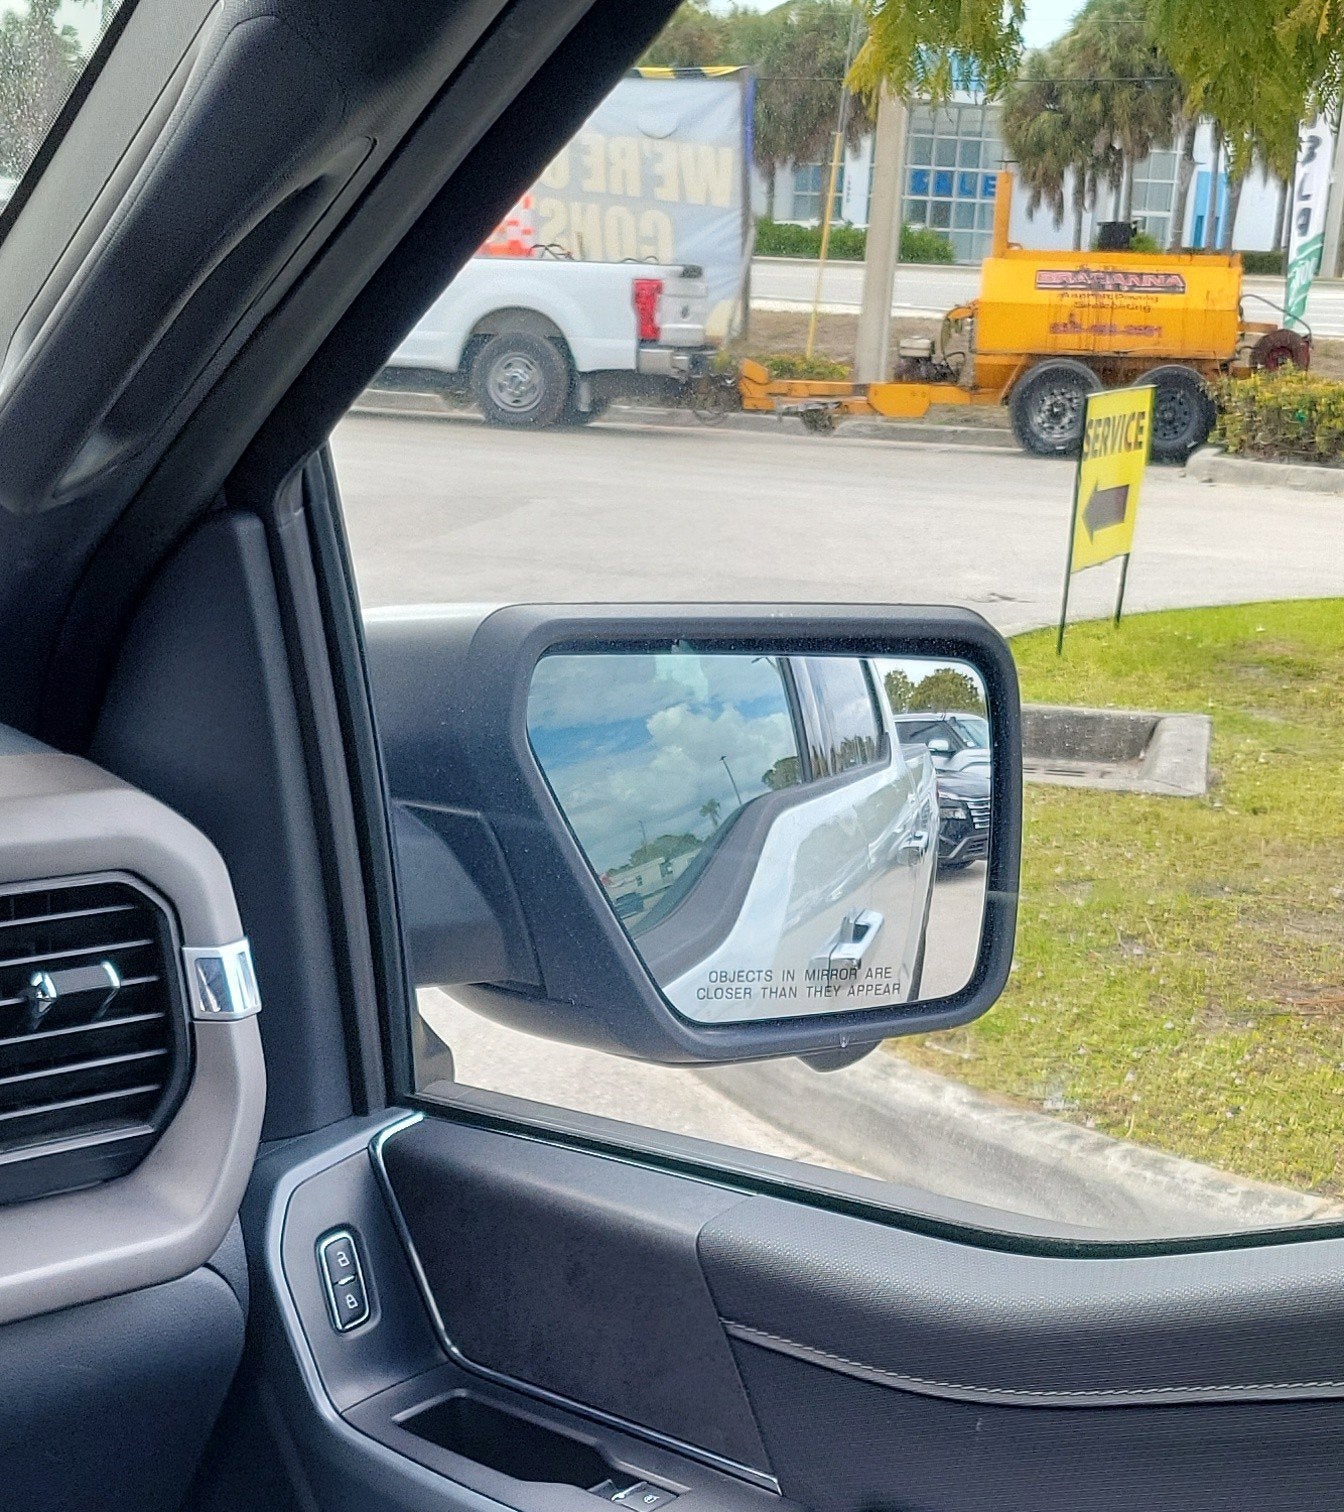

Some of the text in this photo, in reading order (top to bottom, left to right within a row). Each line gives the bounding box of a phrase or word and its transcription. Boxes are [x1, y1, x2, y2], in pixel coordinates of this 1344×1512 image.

[1082, 411, 1146, 461] SERVICE
[708, 966, 892, 983] OBJECTS IN MIRROR ARE
[696, 983, 900, 1000] CLOSER THAN THEY APPEAR
